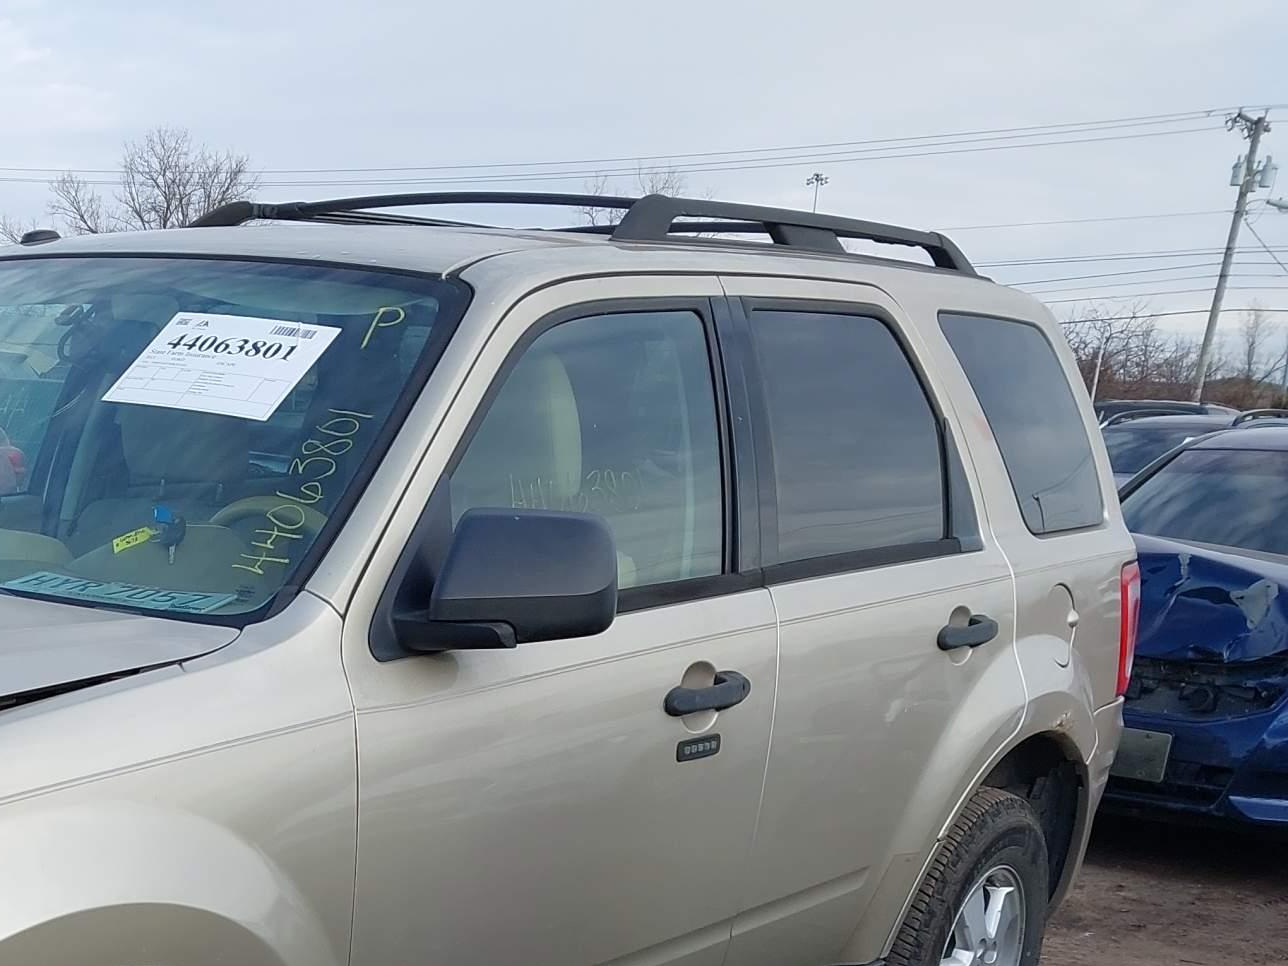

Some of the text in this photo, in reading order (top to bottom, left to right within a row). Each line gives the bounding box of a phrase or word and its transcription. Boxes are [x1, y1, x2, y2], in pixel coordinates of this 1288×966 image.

[166, 332, 299, 362] 44063801
[360, 306, 406, 350] P
[231, 407, 374, 575] 44063801
[20, 574, 102, 593] HYR
[104, 584, 213, 607] 7057
